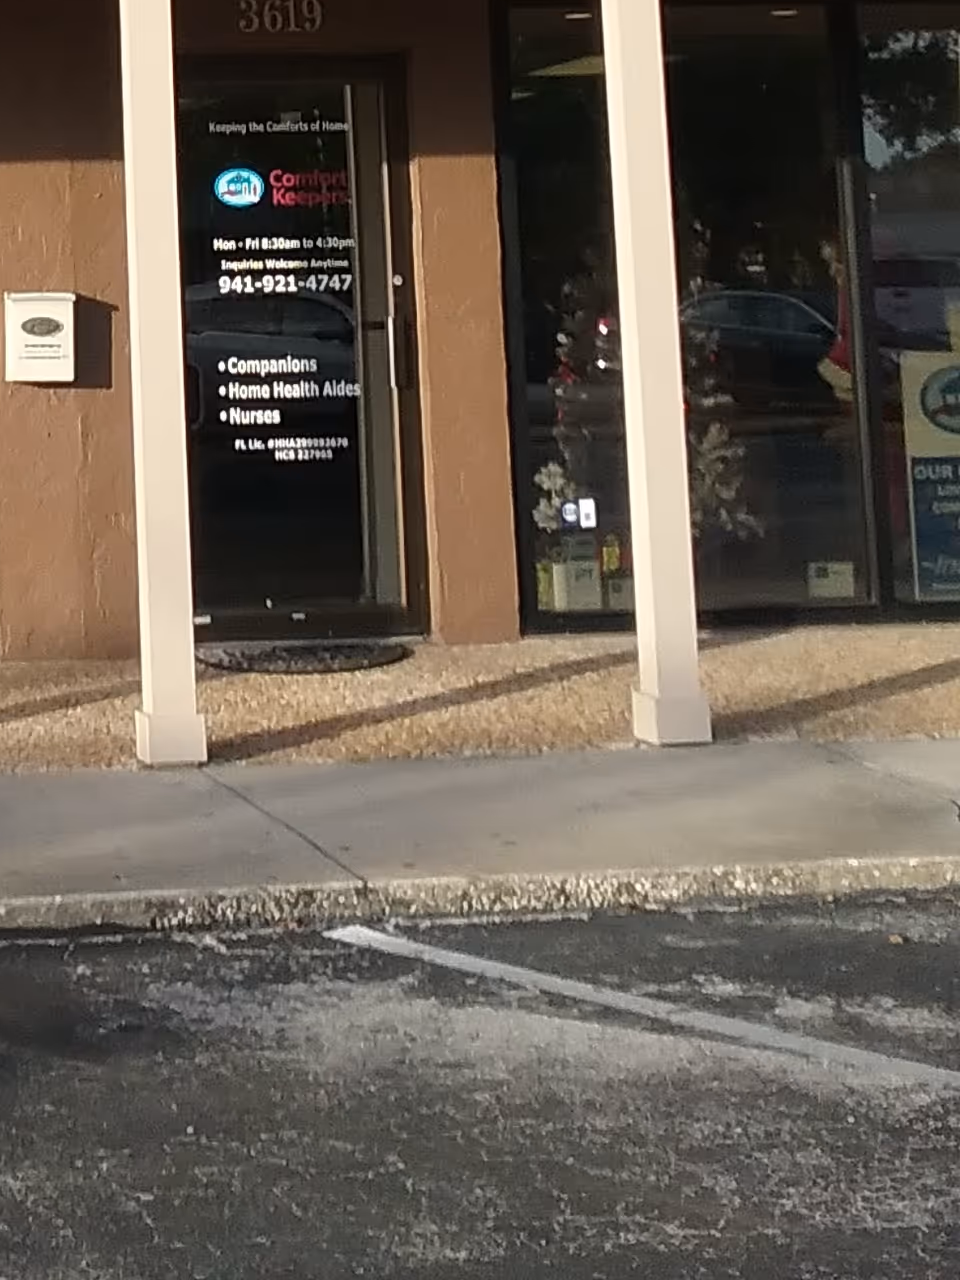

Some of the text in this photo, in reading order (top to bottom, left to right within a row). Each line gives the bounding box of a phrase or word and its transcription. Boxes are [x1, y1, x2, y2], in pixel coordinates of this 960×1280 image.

[209, 121, 348, 135] Keeping the Comforts of Home
[269, 169, 348, 187] Comfort
[213, 238, 236, 251] Mon
[245, 238, 259, 250] Fri
[261, 237, 300, 250] 8:30am
[302, 238, 313, 248] to
[316, 237, 356, 249] 4:30pm
[220, 258, 349, 271] Inquiries Welcome Anytime
[218, 274, 352, 294] 941-921-4747
[227, 355, 317, 377] Companions
[228, 380, 361, 400] Home Health Aides
[229, 407, 281, 425] Nurses
